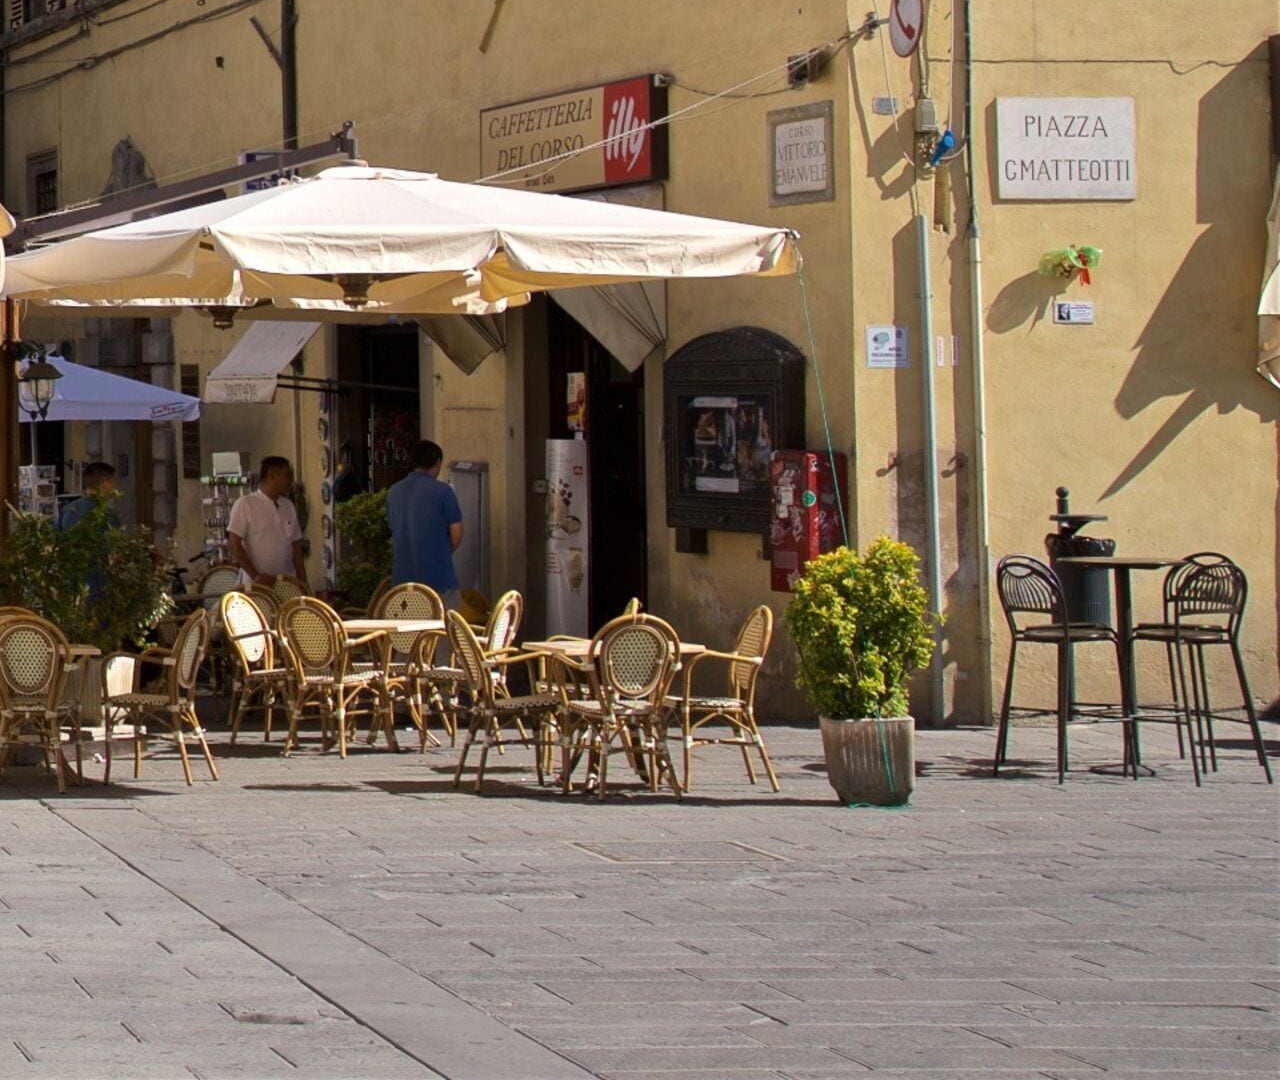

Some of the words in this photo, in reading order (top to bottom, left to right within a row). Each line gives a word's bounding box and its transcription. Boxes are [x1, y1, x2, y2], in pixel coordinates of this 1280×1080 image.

[489, 97, 593, 139] CAFFETTERIA
[606, 96, 646, 172] illy
[789, 126, 814, 138] CORSO
[1024, 115, 1108, 138] PIAZZA
[497, 145, 525, 171] DEL
[530, 134, 584, 166] CORSO
[776, 140, 826, 162] VITTORIO
